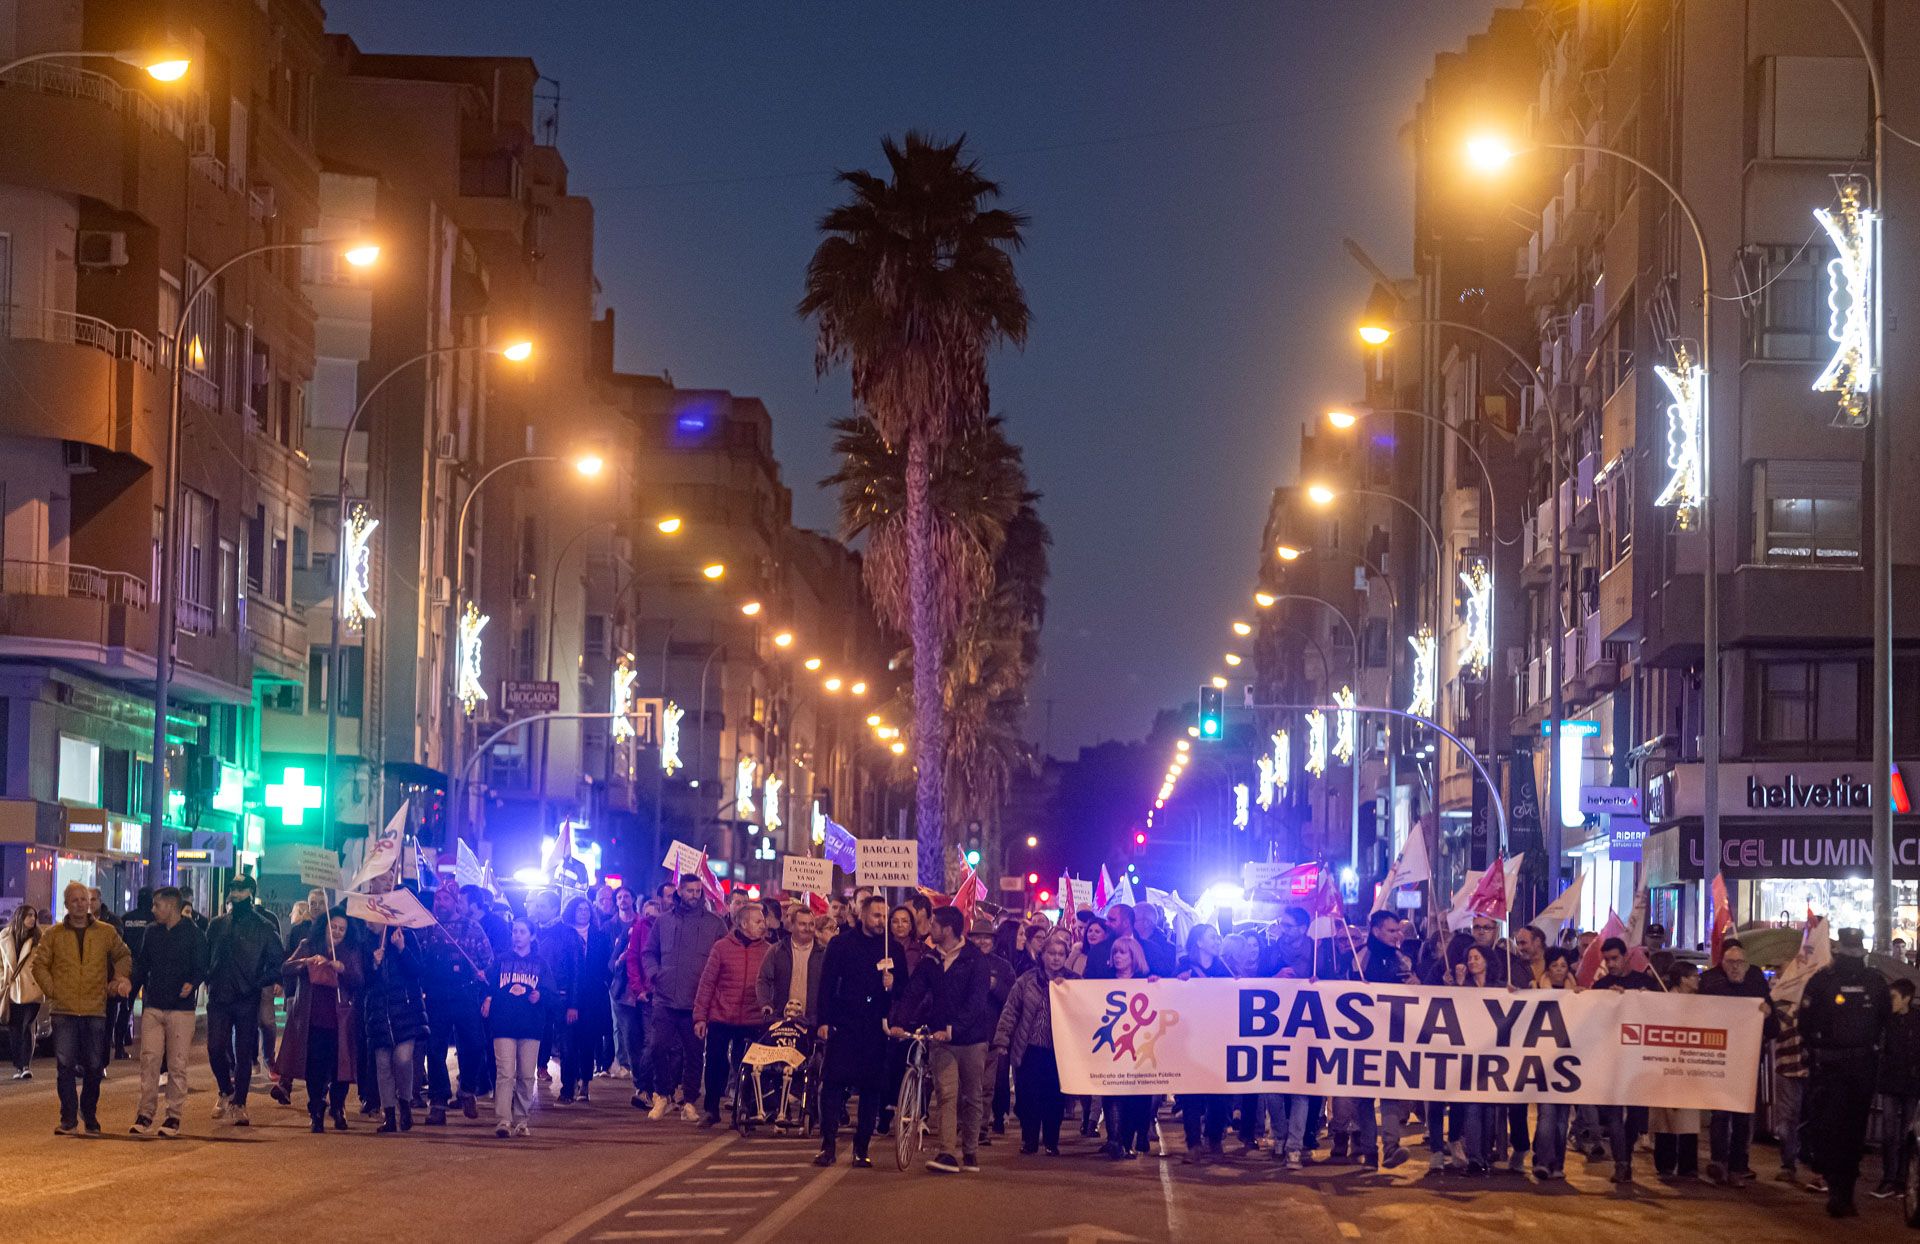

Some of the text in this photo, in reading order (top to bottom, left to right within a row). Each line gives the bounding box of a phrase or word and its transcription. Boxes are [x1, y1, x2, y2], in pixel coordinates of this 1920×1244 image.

[510, 691, 557, 703] ABOGADOS
[1746, 774, 1872, 809] helvetia
[1587, 795, 1626, 805] helvetia
[862, 845, 910, 854] BARCALA
[1689, 838, 1773, 867] LCEL
[792, 859, 822, 868] BARCALA
[799, 867, 824, 875] CIUDAD
[864, 872, 910, 881] PALABRA!
[1238, 988, 1572, 1049] BASTA YA
[1648, 1029, 1701, 1045] CCOO
[1642, 1055, 1669, 1063] serveis
[1226, 1045, 1582, 1093] DE MENTIRAS
